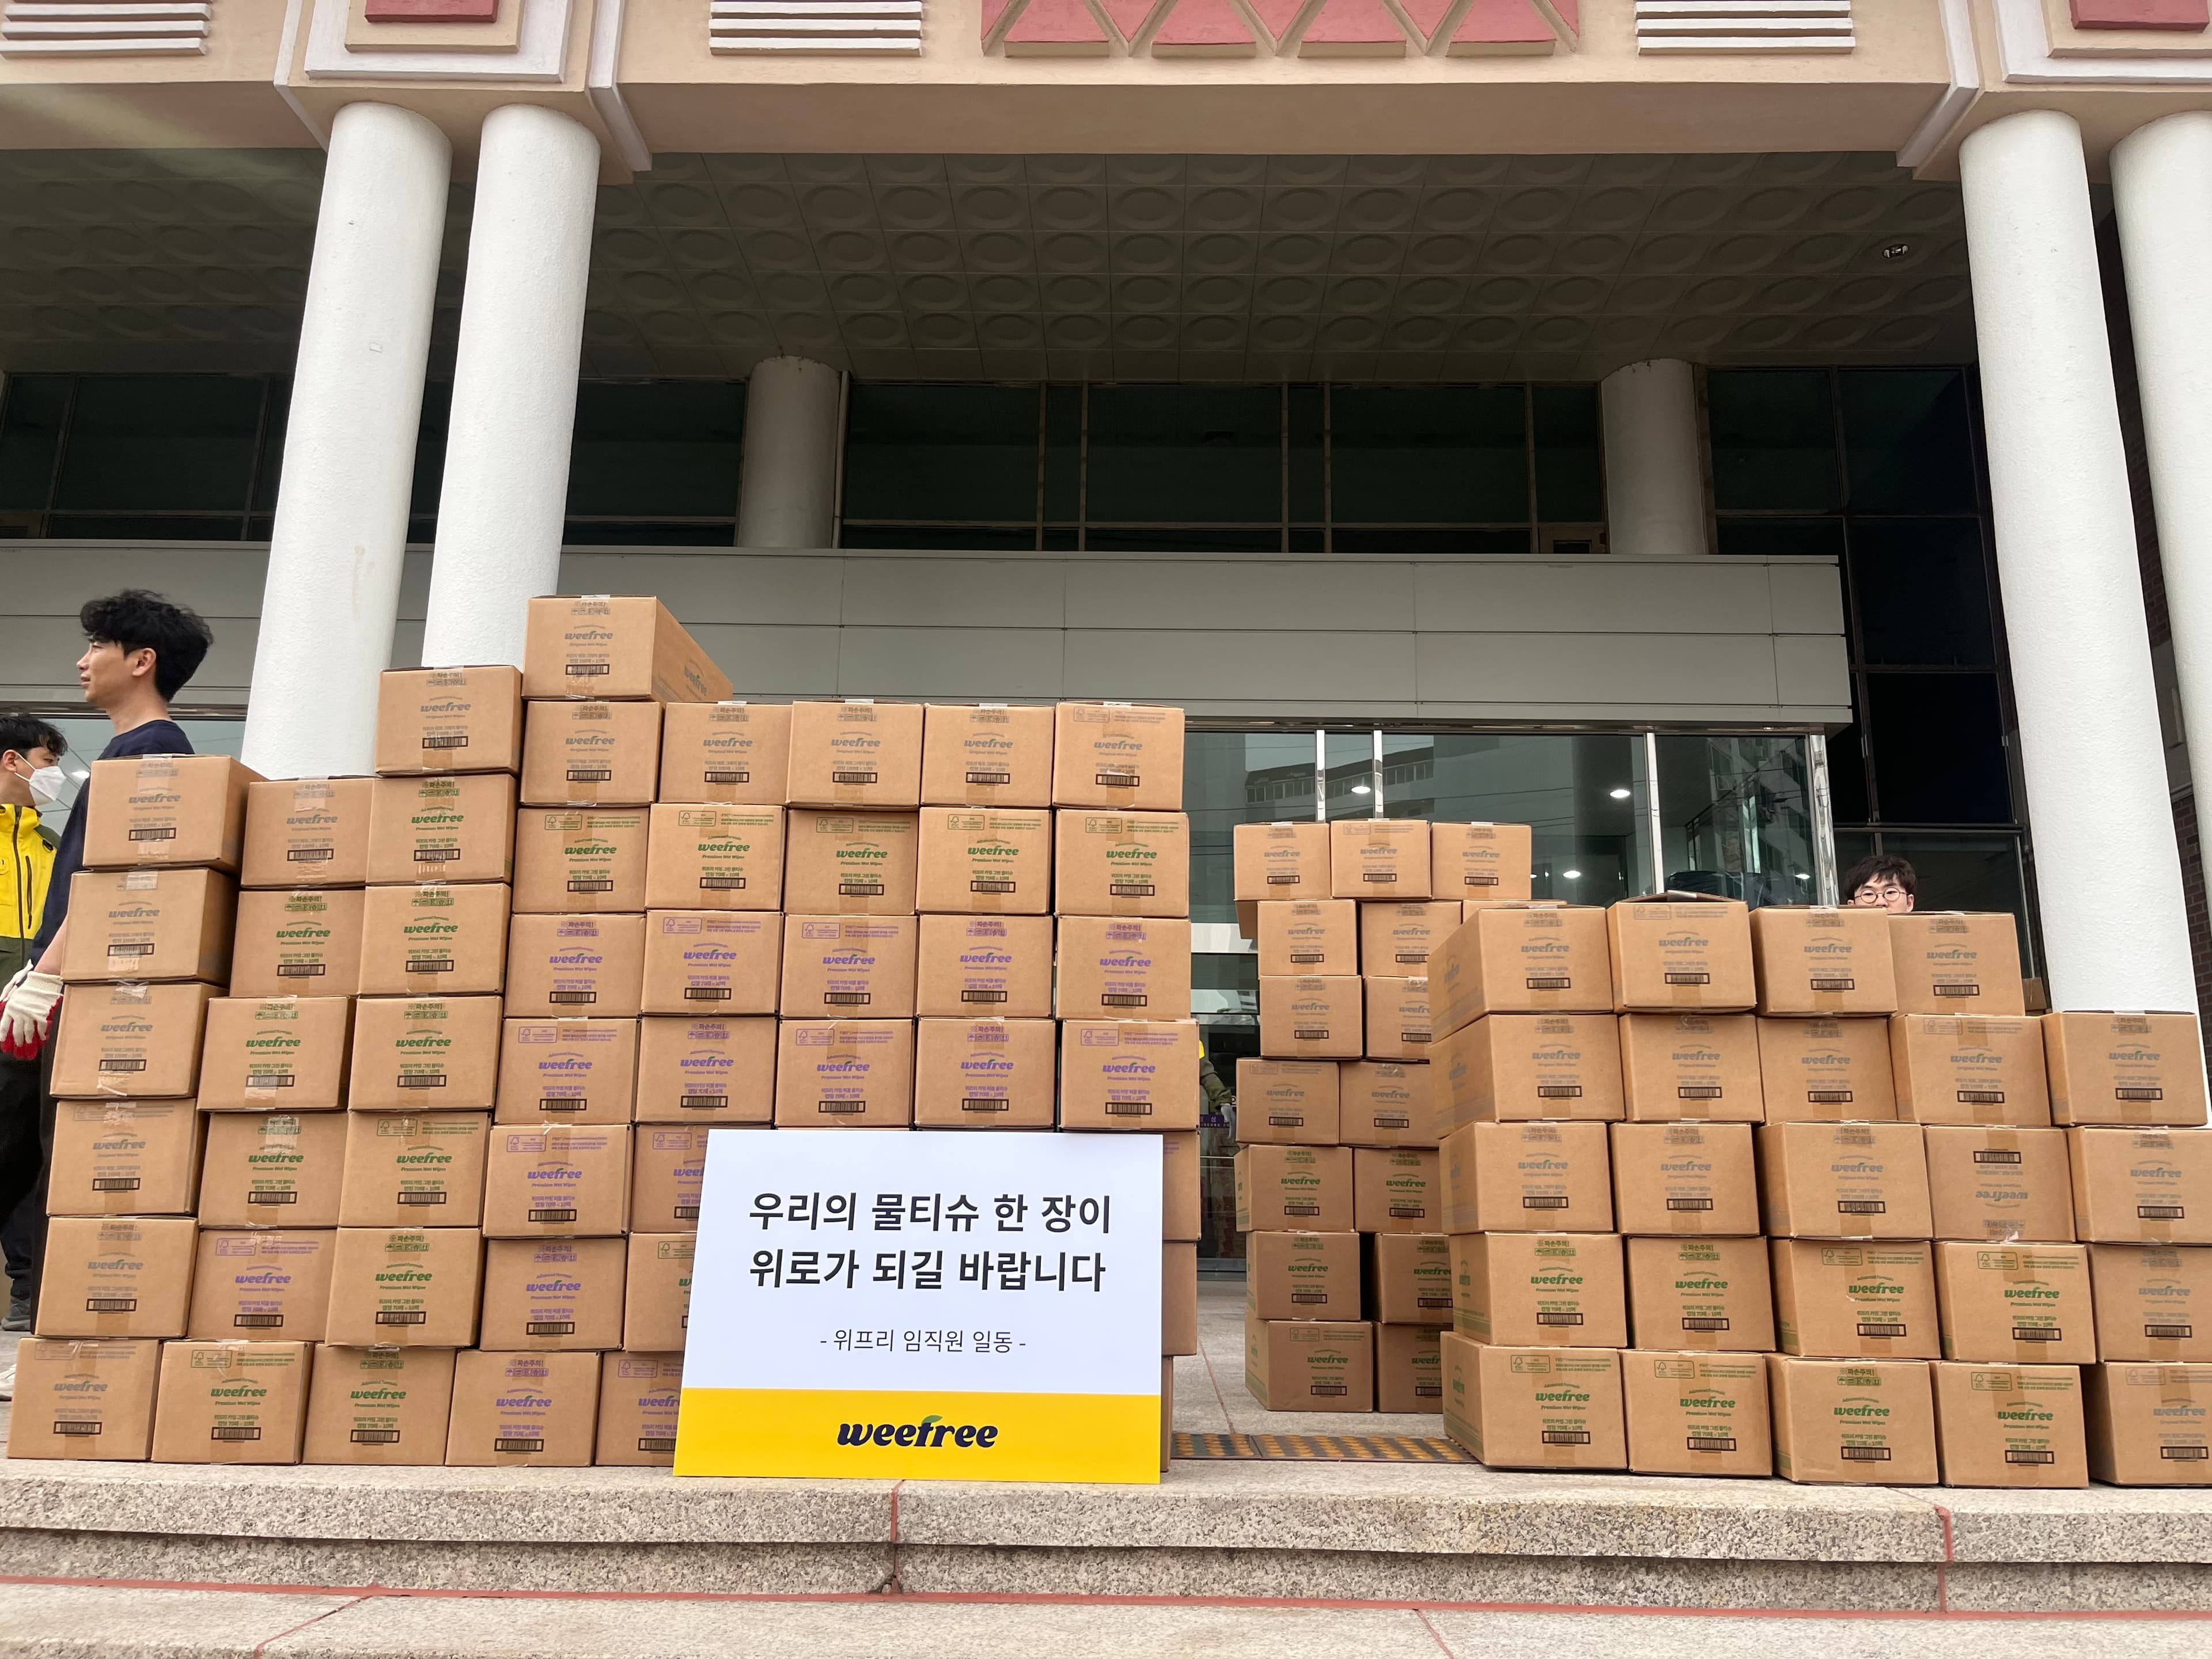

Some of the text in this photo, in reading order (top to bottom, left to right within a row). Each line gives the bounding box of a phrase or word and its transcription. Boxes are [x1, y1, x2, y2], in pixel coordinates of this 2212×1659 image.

[565, 631, 613, 639] weefree
[421, 702, 471, 712] weefree
[566, 736, 615, 744] weefree
[703, 737, 753, 747] weefree
[831, 738, 881, 747] weefree
[964, 738, 1013, 748] weefree
[1094, 740, 1143, 750] weefree
[129, 793, 181, 804] weefree
[287, 814, 338, 824] weefree
[412, 813, 464, 823] weefree
[565, 844, 616, 854] weefree
[698, 842, 750, 851] weefree
[968, 846, 1018, 855] weefree
[836, 848, 887, 858] weefree
[1107, 848, 1157, 858] weefree
[109, 908, 160, 918] weefree
[276, 927, 330, 938] weefree
[404, 923, 458, 933] weefree
[1659, 937, 1708, 946] weefree
[1521, 943, 1570, 952] weefree
[1804, 944, 1853, 953] weefree
[550, 953, 603, 963] weefree
[684, 949, 737, 959] weefree
[823, 954, 875, 964] weefree
[960, 952, 1012, 963] weefree
[1927, 949, 1977, 959] weefree
[1100, 956, 1151, 967] weefree
[101, 1022, 153, 1032] weefree
[246, 1036, 301, 1047] weefree
[396, 1036, 451, 1047] weefree
[1532, 1050, 1581, 1059] weefree
[1672, 1051, 1720, 1060] weefree
[1802, 1055, 1850, 1064] weefree
[1950, 1054, 2002, 1063] weefree
[2109, 1051, 2160, 1060] weefree
[539, 1059, 592, 1069] weefree
[680, 1056, 733, 1067] weefree
[817, 1061, 869, 1071] weefree
[961, 1059, 1013, 1070] weefree
[1103, 1062, 1156, 1073] weefree
[1372, 1090, 1410, 1099] weefree
[93, 1139, 145, 1150] weefree
[249, 1152, 304, 1162] weefree
[396, 1152, 452, 1163] weefree
[1518, 1160, 1567, 1169] weefree
[1661, 1161, 1711, 1171] weefree
[1832, 1162, 1883, 1172] weefree
[528, 1168, 582, 1179] weefree
[2131, 1168, 2181, 1177] weefree
[1387, 1179, 1426, 1187] weefree
[750, 1192, 1109, 1233] 우리의 물티슈 한 장이
[88, 1259, 143, 1270] weefree
[750, 1249, 1105, 1291] 위로가 되길 바랍니다
[235, 1272, 290, 1283] weefree
[376, 1270, 432, 1281] weefree
[1531, 1274, 1583, 1285] weefree
[527, 1280, 581, 1291] weefree
[1676, 1278, 1728, 1289] weefree
[1849, 1282, 1904, 1293] weefree
[2005, 1287, 2059, 1298] weefree
[2139, 1286, 2190, 1296] weefree
[834, 1330, 893, 1351] 위프리
[904, 1330, 963, 1352] 임직원
[974, 1331, 1012, 1353] 일동
[1308, 1355, 1348, 1363] weefree
[1412, 1355, 1440, 1363] weefr
[55, 1381, 108, 1391] weefree
[211, 1385, 267, 1396] weefree
[351, 1388, 406, 1399] weefree
[1536, 1390, 1590, 1401] weefree
[497, 1396, 552, 1407] weefree
[638, 1395, 680, 1407] weefr
[1680, 1396, 1736, 1408] weefree
[1834, 1405, 1889, 1416] weefree
[1998, 1409, 2053, 1421] weefree
[2153, 1405, 2206, 1416] weefree
[838, 1415, 998, 1448] weefree
